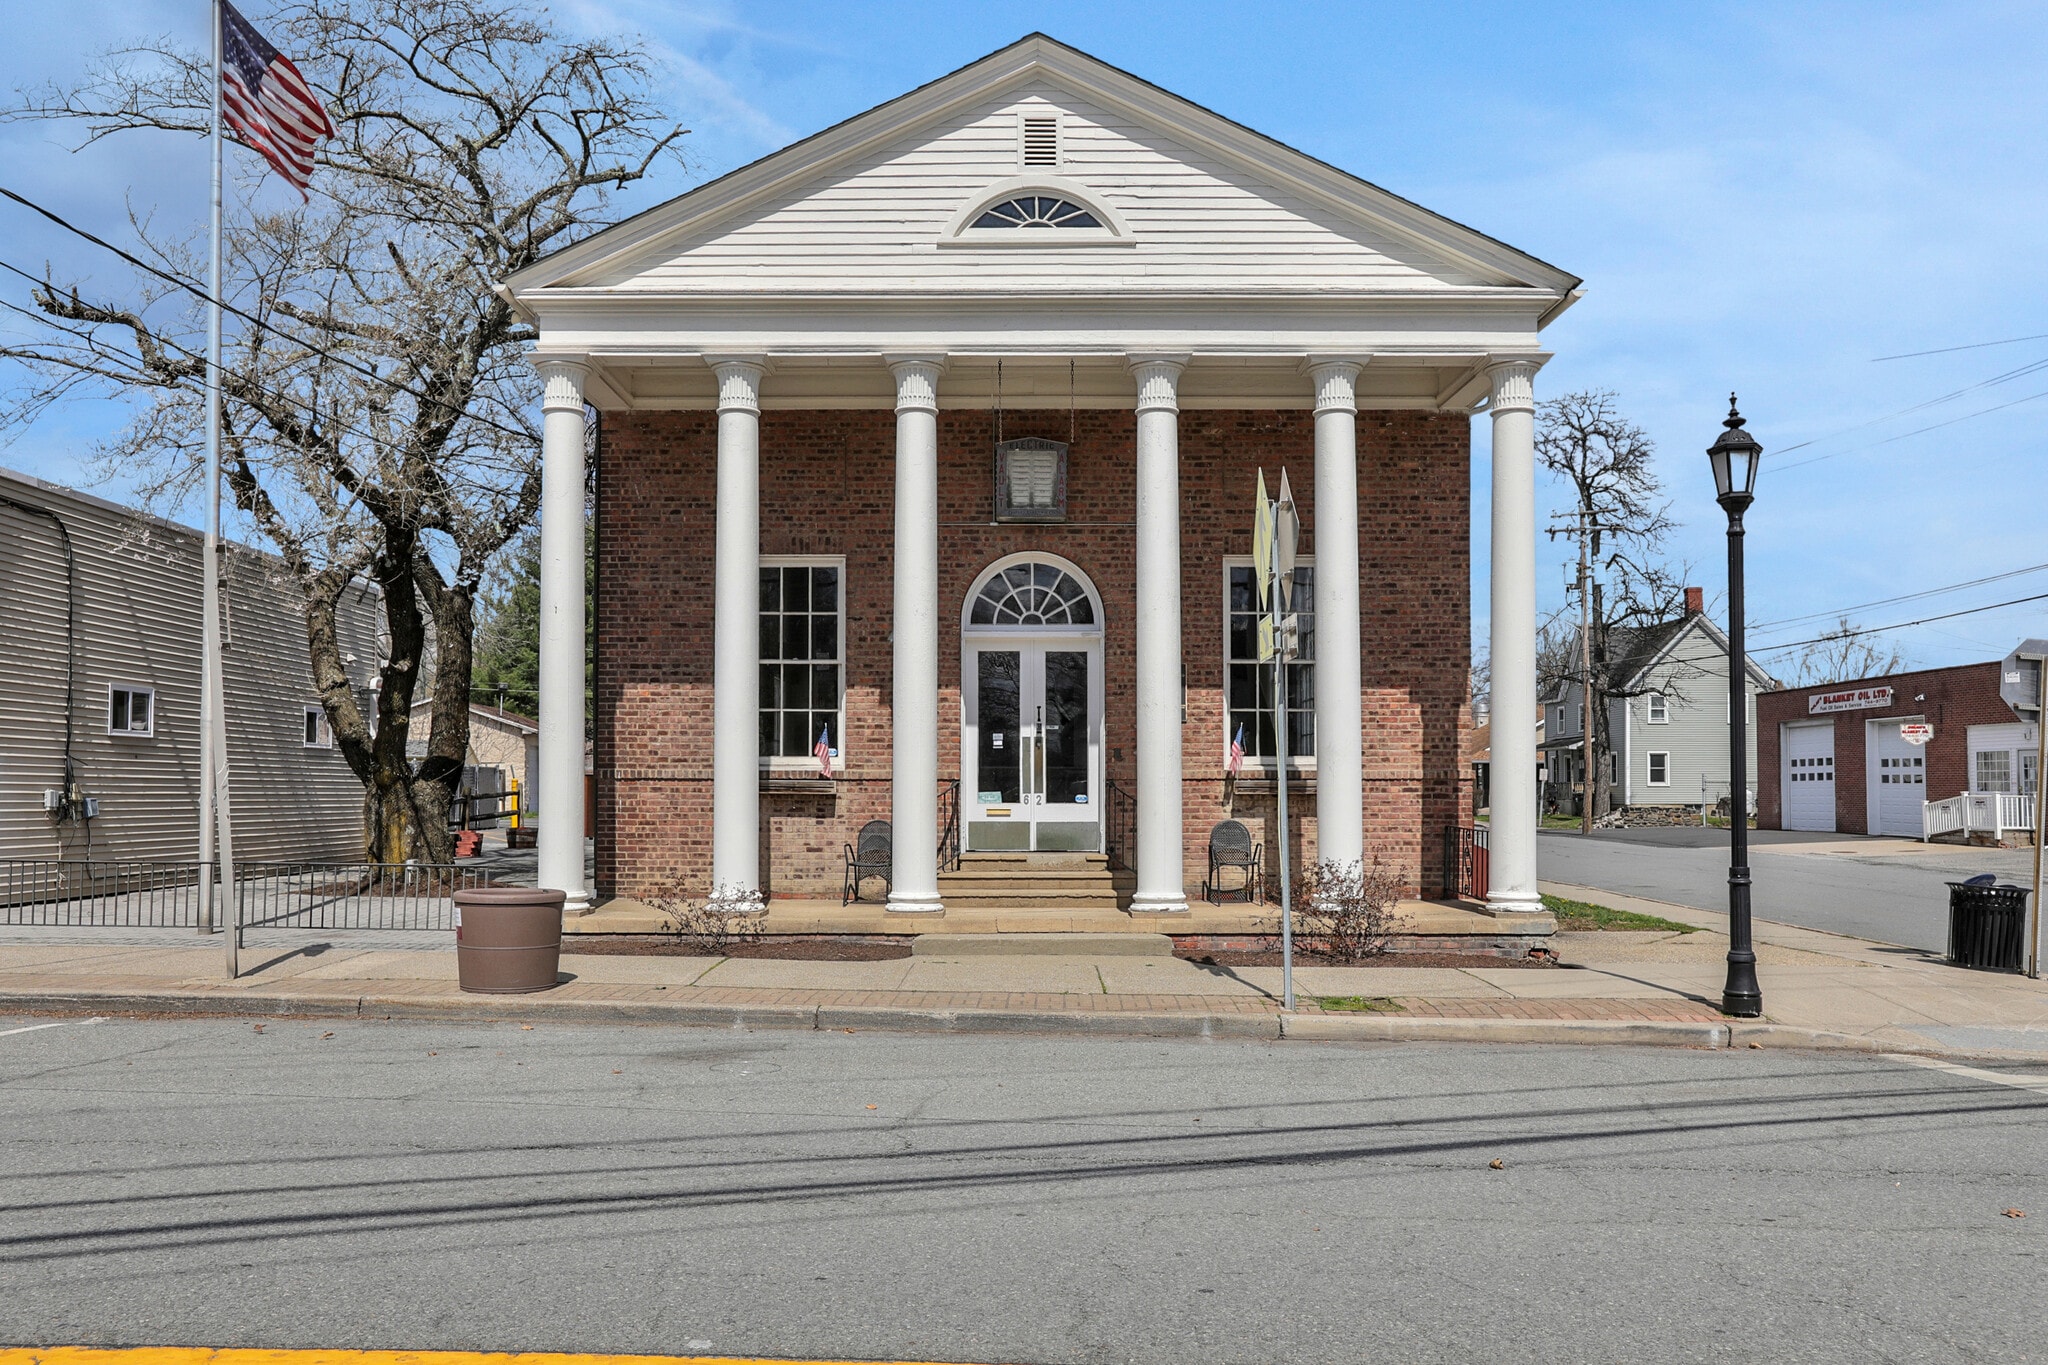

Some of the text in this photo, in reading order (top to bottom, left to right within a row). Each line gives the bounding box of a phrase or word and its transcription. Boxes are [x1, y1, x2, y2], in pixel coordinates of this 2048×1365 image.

[1009, 440, 1055, 449] ELECTRIC
[998, 453, 1006, 507] VAULT
[1823, 692, 1855, 704] BLANKET
[1858, 690, 1870, 700] OIL
